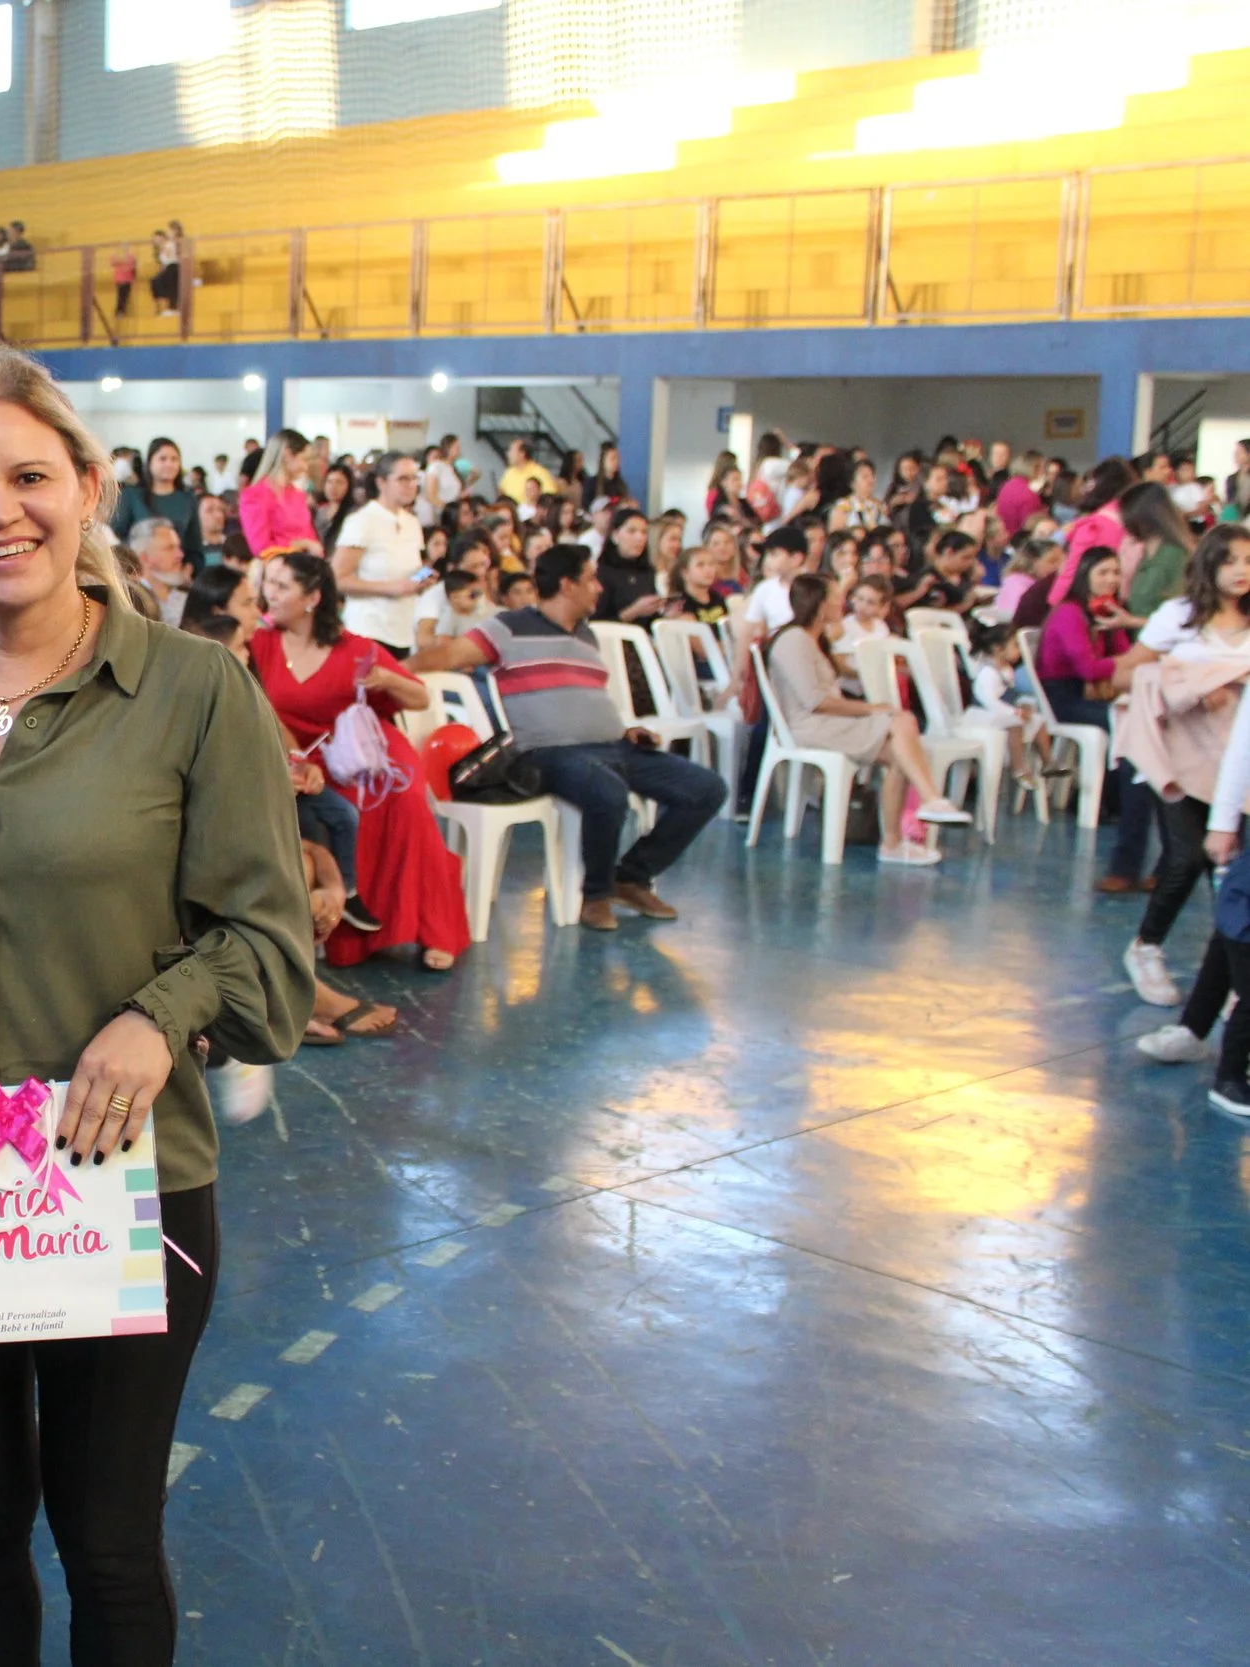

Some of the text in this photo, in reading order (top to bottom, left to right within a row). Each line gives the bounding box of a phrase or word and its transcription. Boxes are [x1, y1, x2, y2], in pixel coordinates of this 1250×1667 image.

[7, 1308, 67, 1320] Personalizado
[0, 1322, 21, 1333] Bebê
[31, 1321, 64, 1331] Infantil
